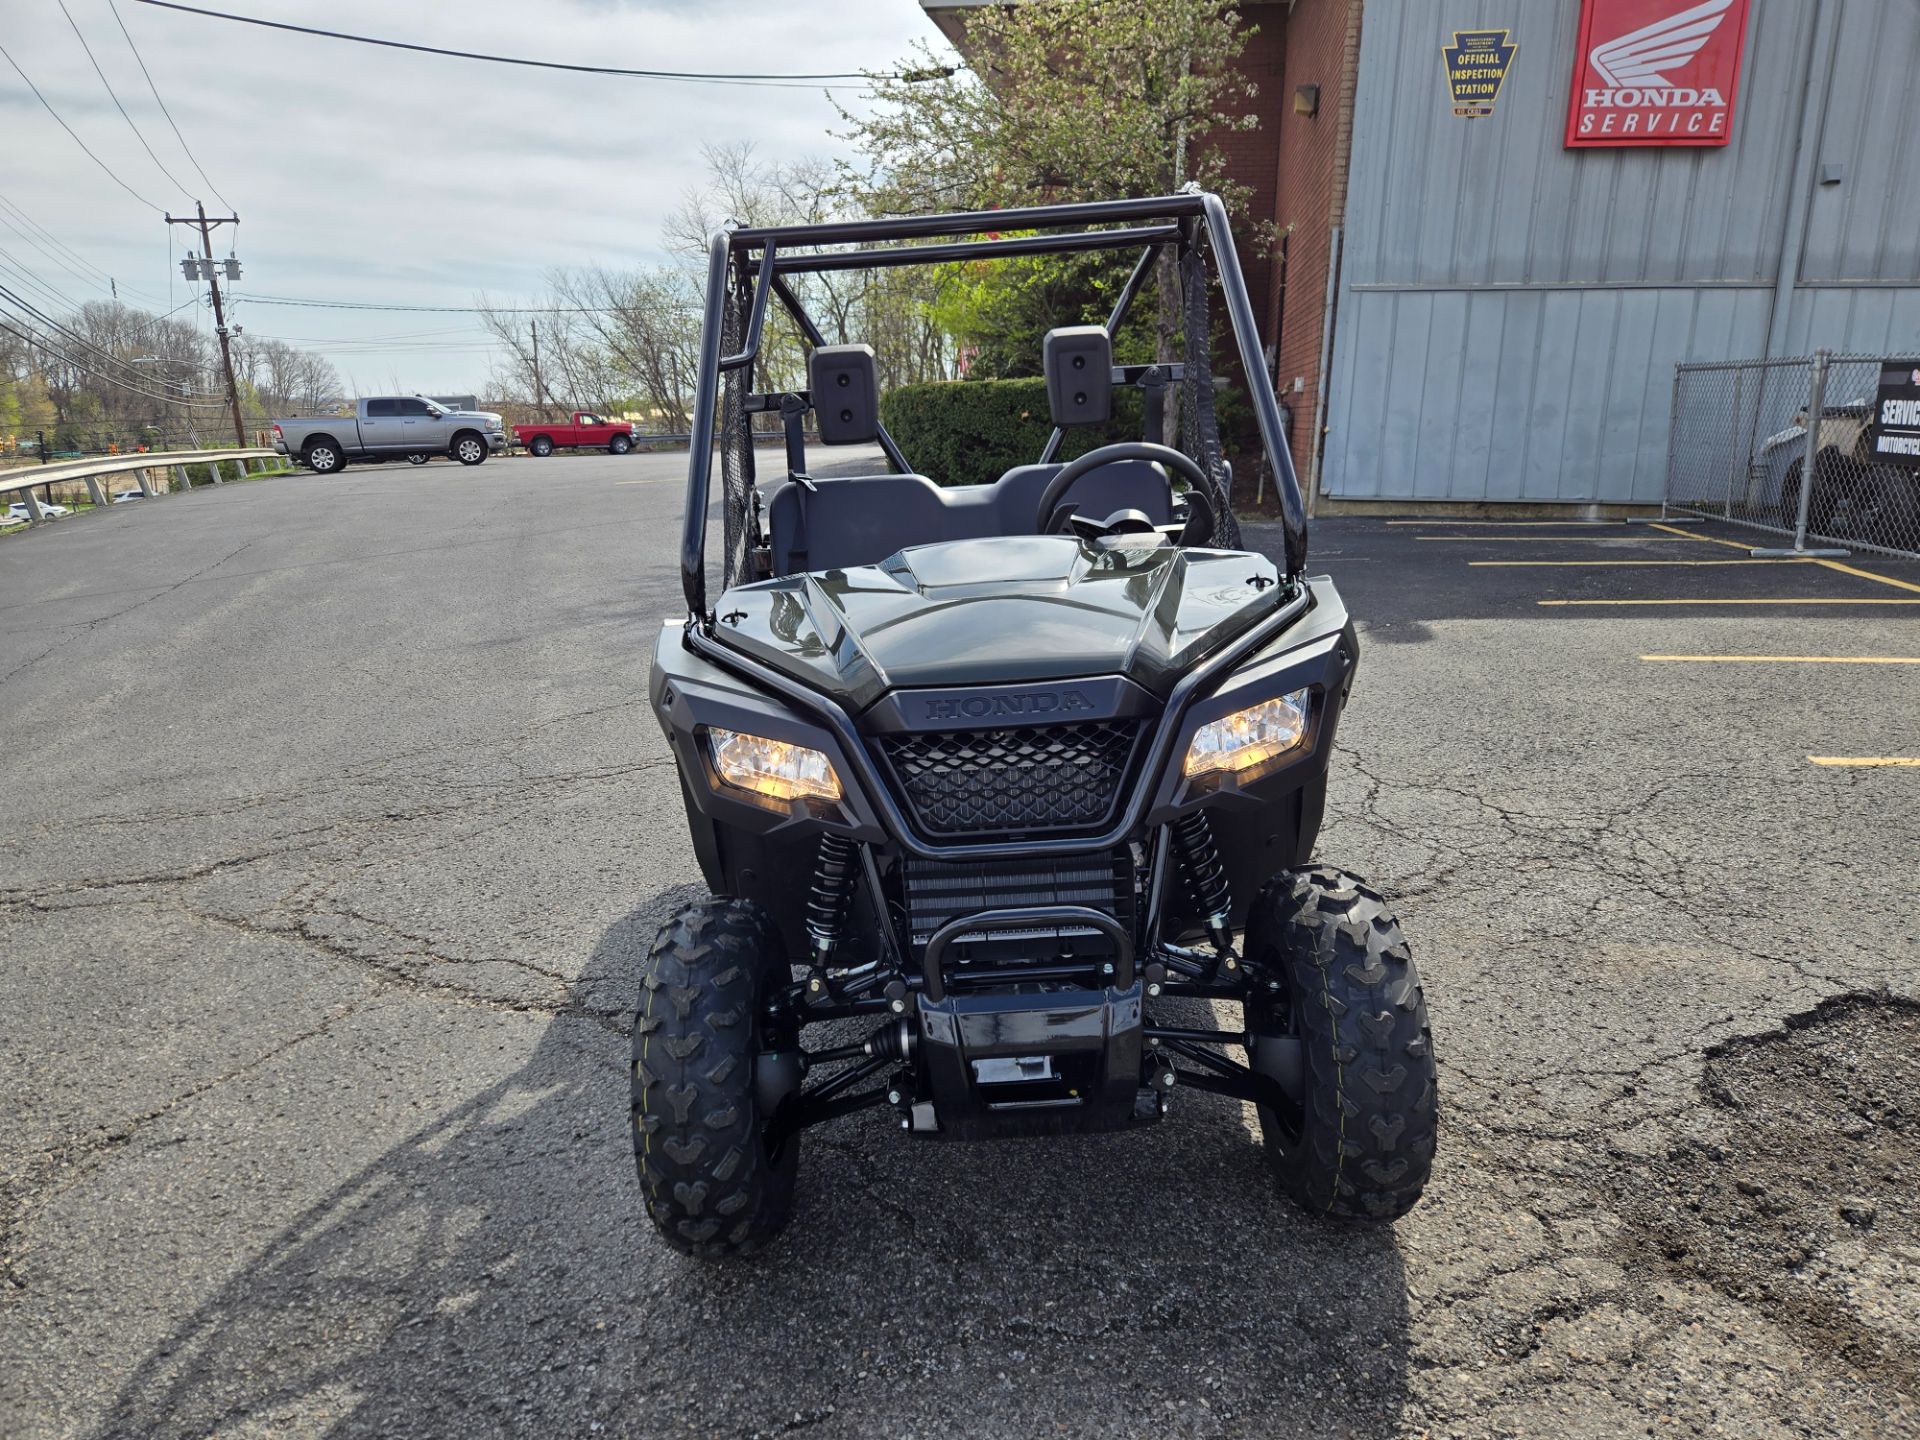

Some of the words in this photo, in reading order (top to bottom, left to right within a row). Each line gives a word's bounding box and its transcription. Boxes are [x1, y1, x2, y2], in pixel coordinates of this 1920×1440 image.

[1457, 53, 1500, 65] OFFICIAL
[1451, 69, 1503, 80] INSPECTION
[1455, 83, 1495, 95] STATION
[1583, 88, 1727, 108] HONDA
[1580, 112, 1726, 134] SERVICE
[1881, 399, 1920, 426] SERVIC
[1876, 435, 1920, 456] MOTORCYCL
[925, 690, 1095, 720] HONDA
